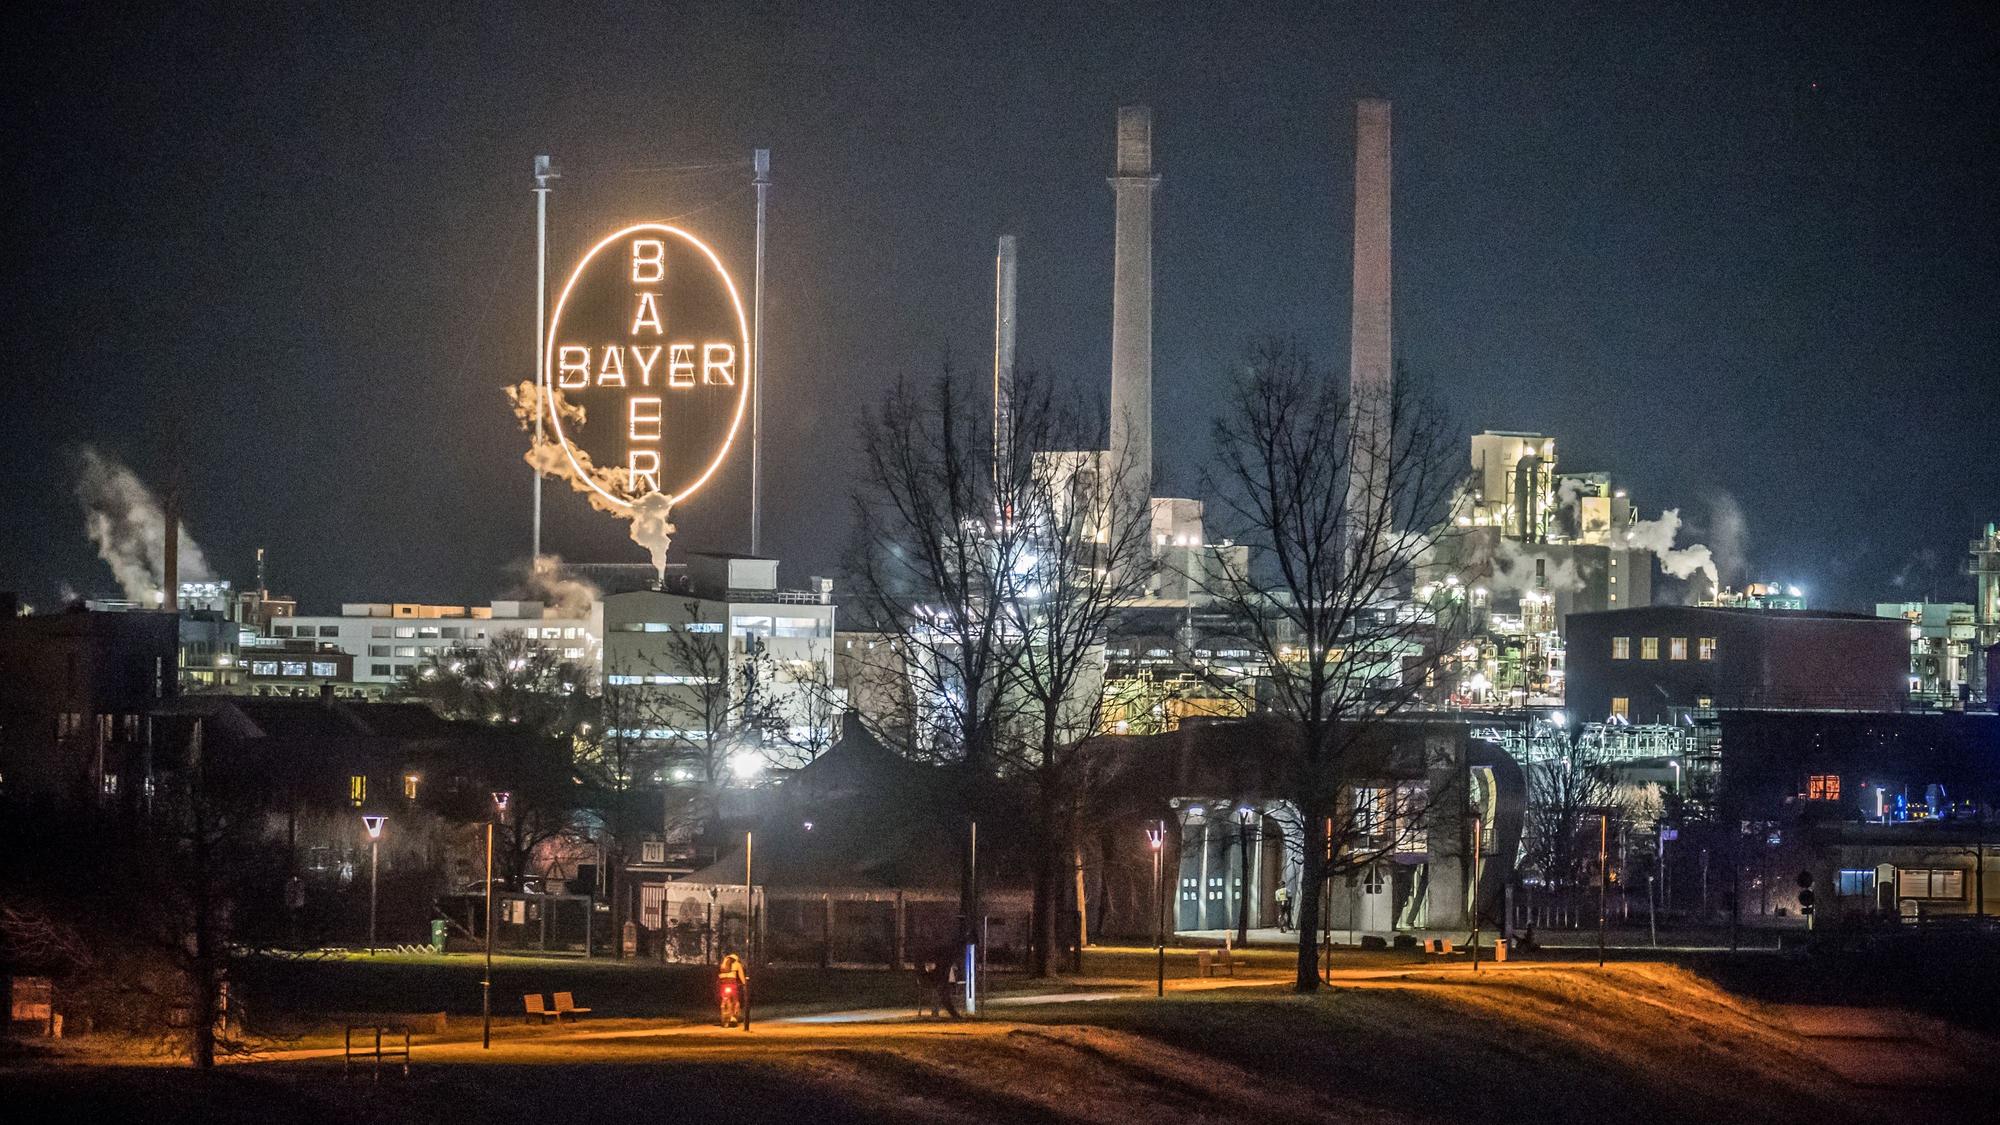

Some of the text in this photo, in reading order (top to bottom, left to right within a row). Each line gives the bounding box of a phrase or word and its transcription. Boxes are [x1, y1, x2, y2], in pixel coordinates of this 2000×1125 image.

[559, 344, 735, 388] BAYER
[630, 239, 664, 492] BAYER
[645, 843, 661, 860] 701
